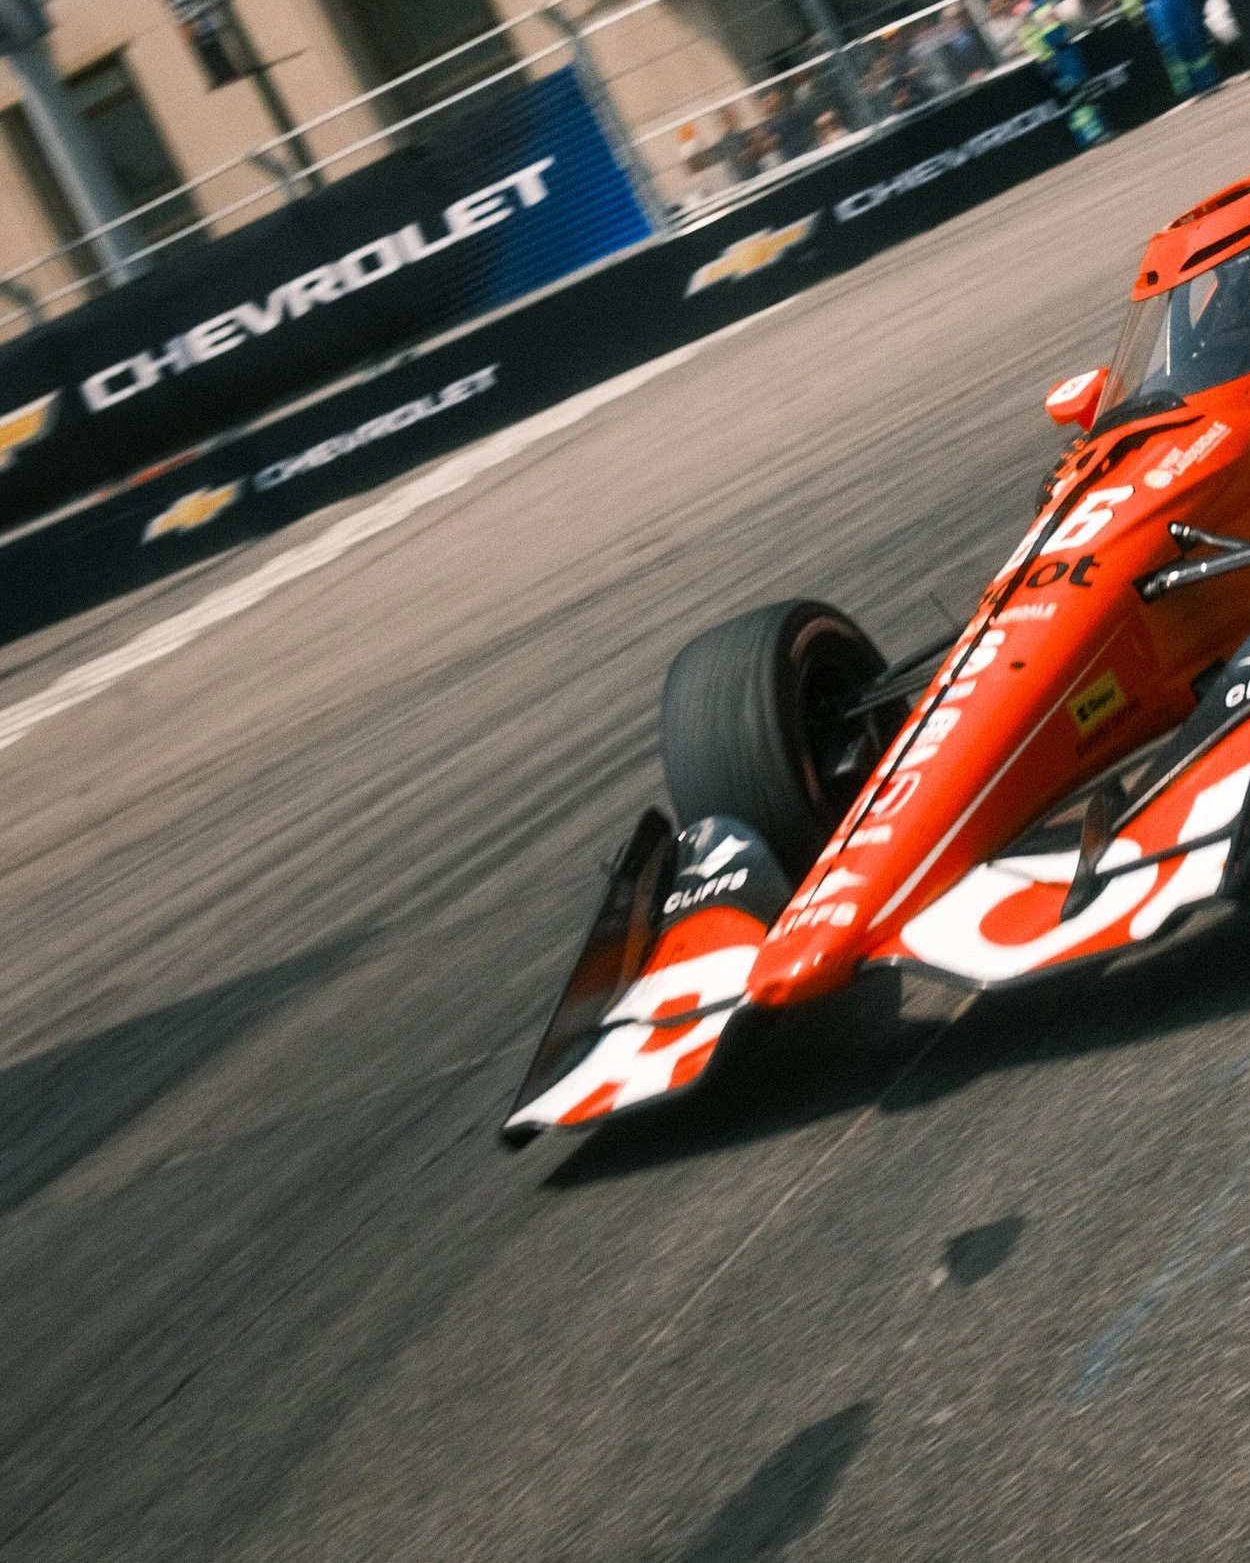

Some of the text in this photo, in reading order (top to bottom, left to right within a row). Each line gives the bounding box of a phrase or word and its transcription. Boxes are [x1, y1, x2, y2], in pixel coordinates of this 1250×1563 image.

[80, 156, 555, 413] CHEVROLET
[253, 364, 499, 491] CHEVROLET
[663, 868, 749, 915] CLIFFS
